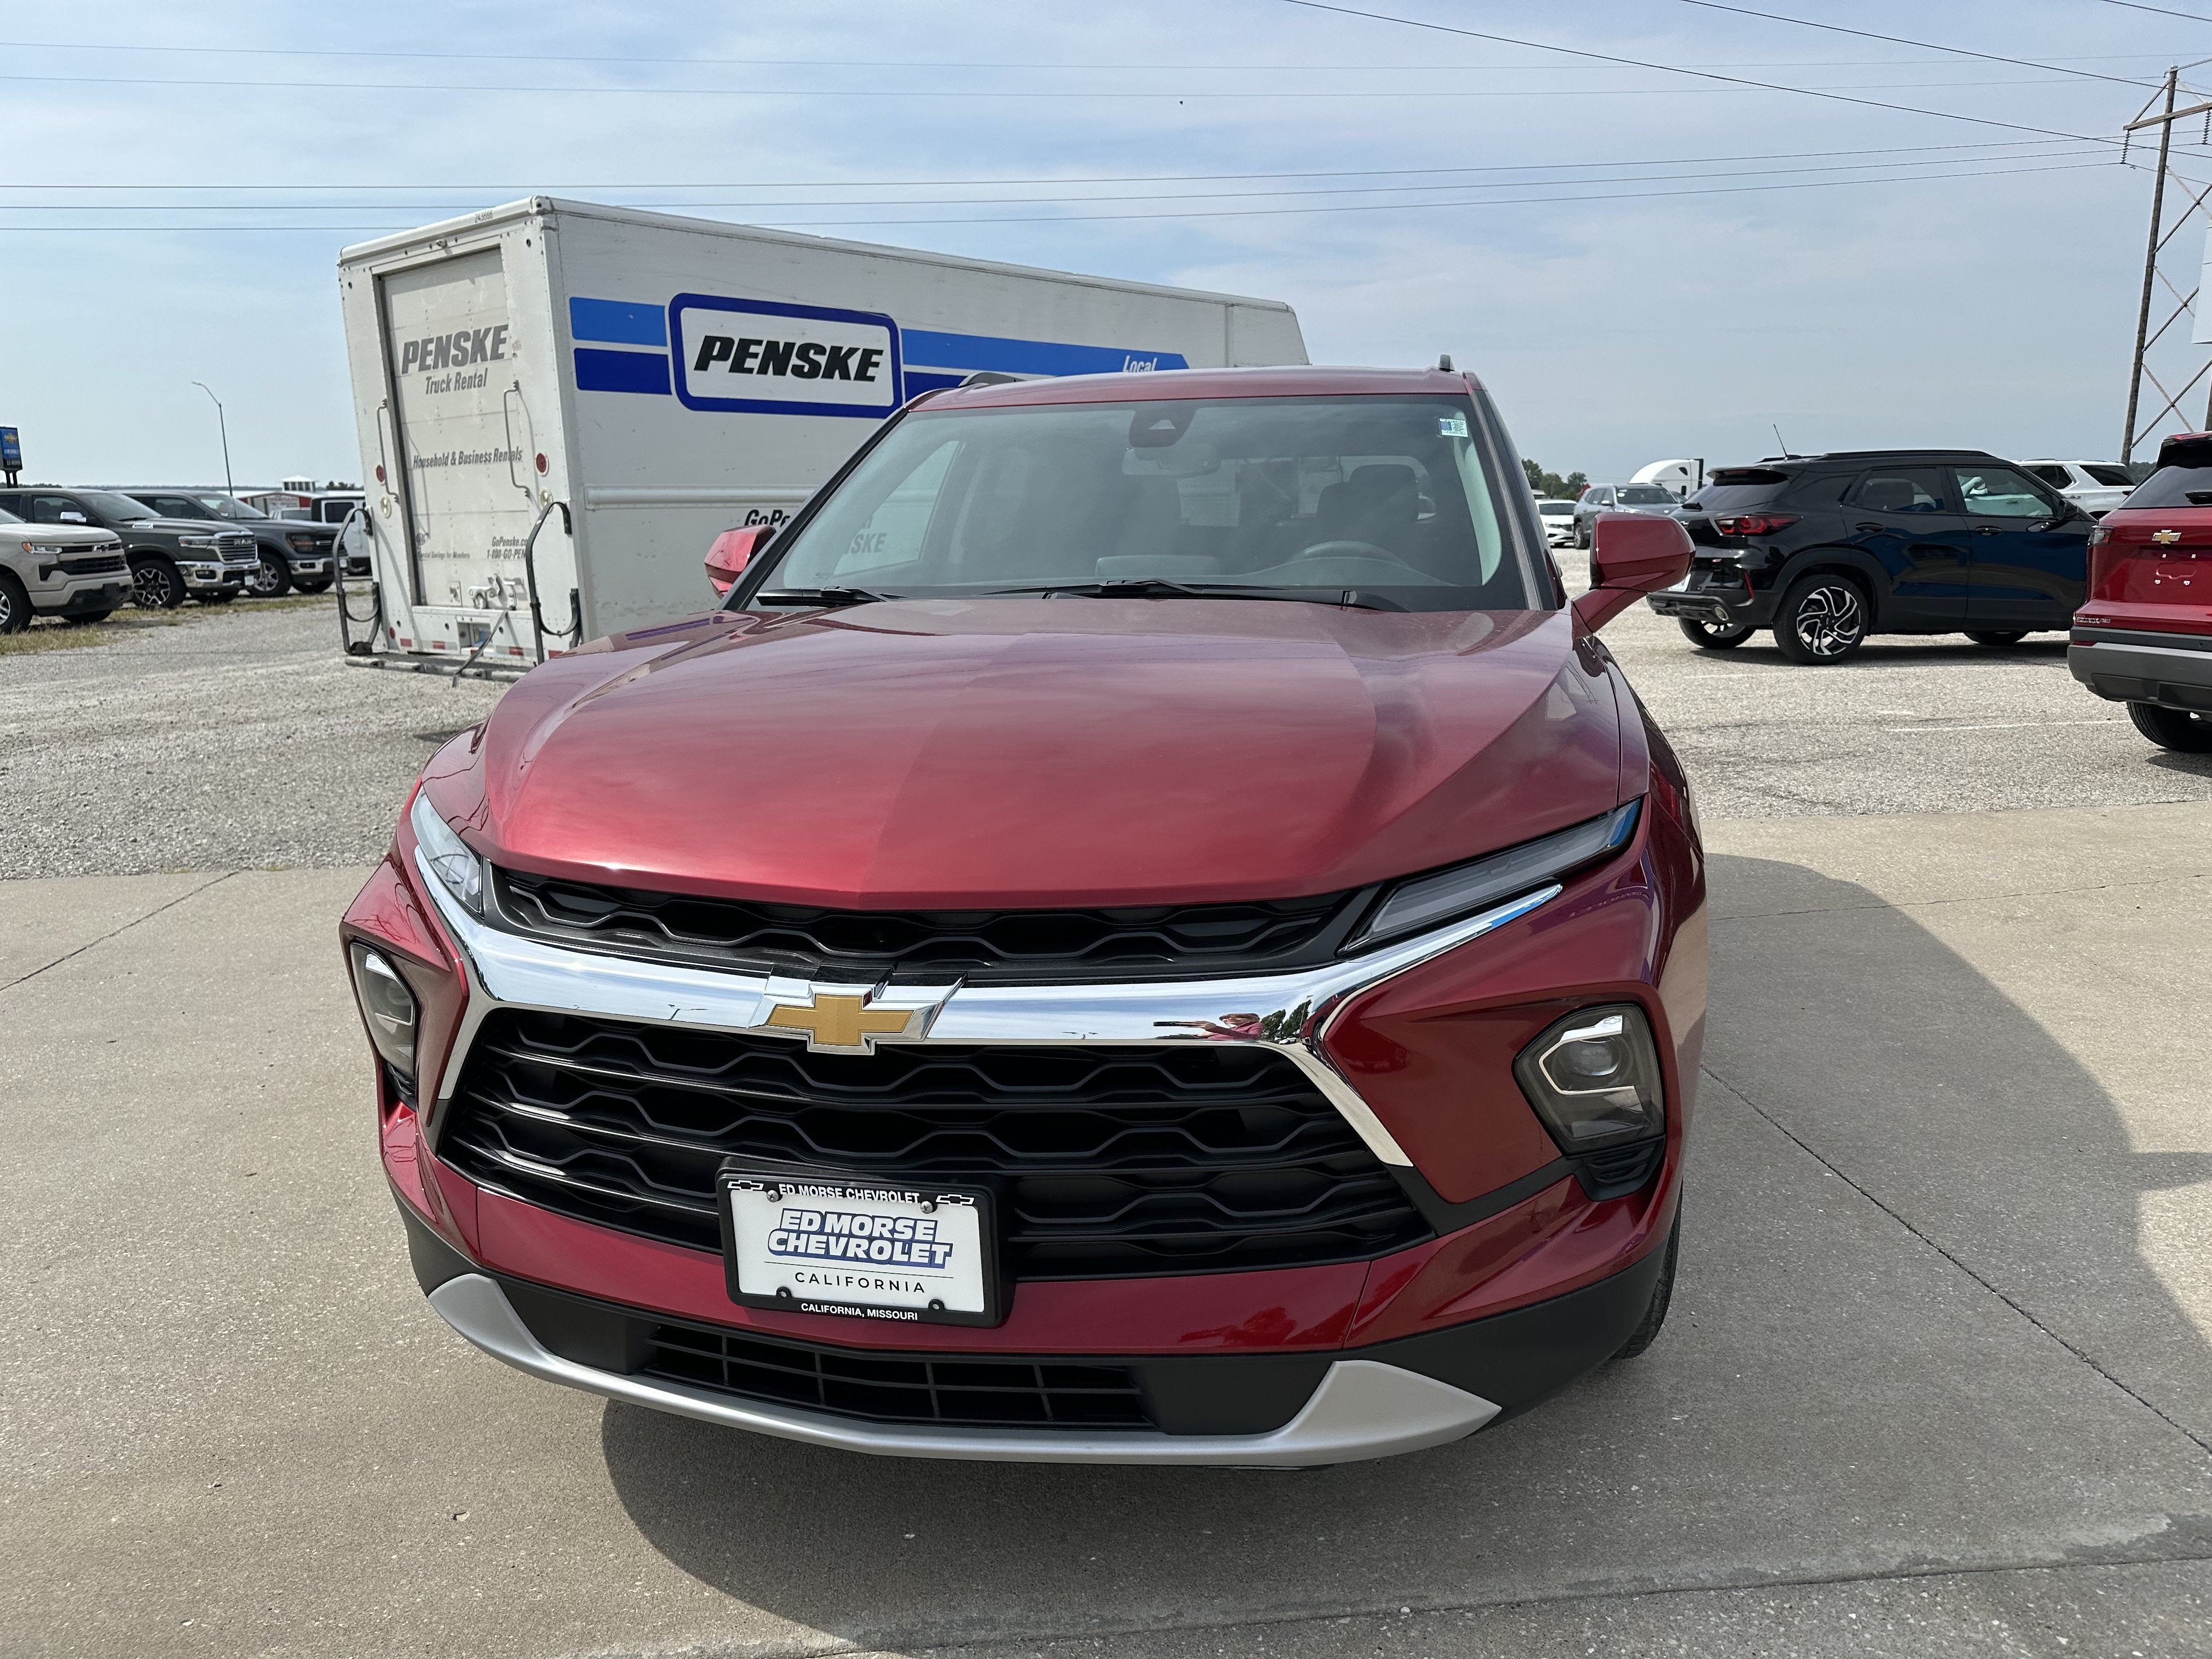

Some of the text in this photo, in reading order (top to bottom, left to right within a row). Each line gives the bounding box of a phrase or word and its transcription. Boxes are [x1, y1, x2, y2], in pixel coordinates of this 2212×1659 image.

[402, 324, 509, 375] PENSKE
[693, 335, 884, 382] PENSKE
[1122, 355, 1158, 373] Local
[426, 368, 488, 395] Truck Rental
[413, 453, 450, 469] Household
[450, 451, 457, 466] &
[458, 449, 493, 465] Business
[492, 535, 528, 547] GoPenske.co
[848, 533, 887, 554] SKE
[487, 549, 527, 560] 1-800-GO-PEN
[778, 1183, 920, 1204] ED MORSE CHEVROLET
[780, 1209, 937, 1242] ED MORSE
[768, 1229, 952, 1267] CHEVROLET
[795, 1272, 925, 1293] CALIFORNIA
[800, 1303, 918, 1321] CALIFORNIA, MISSOURI
